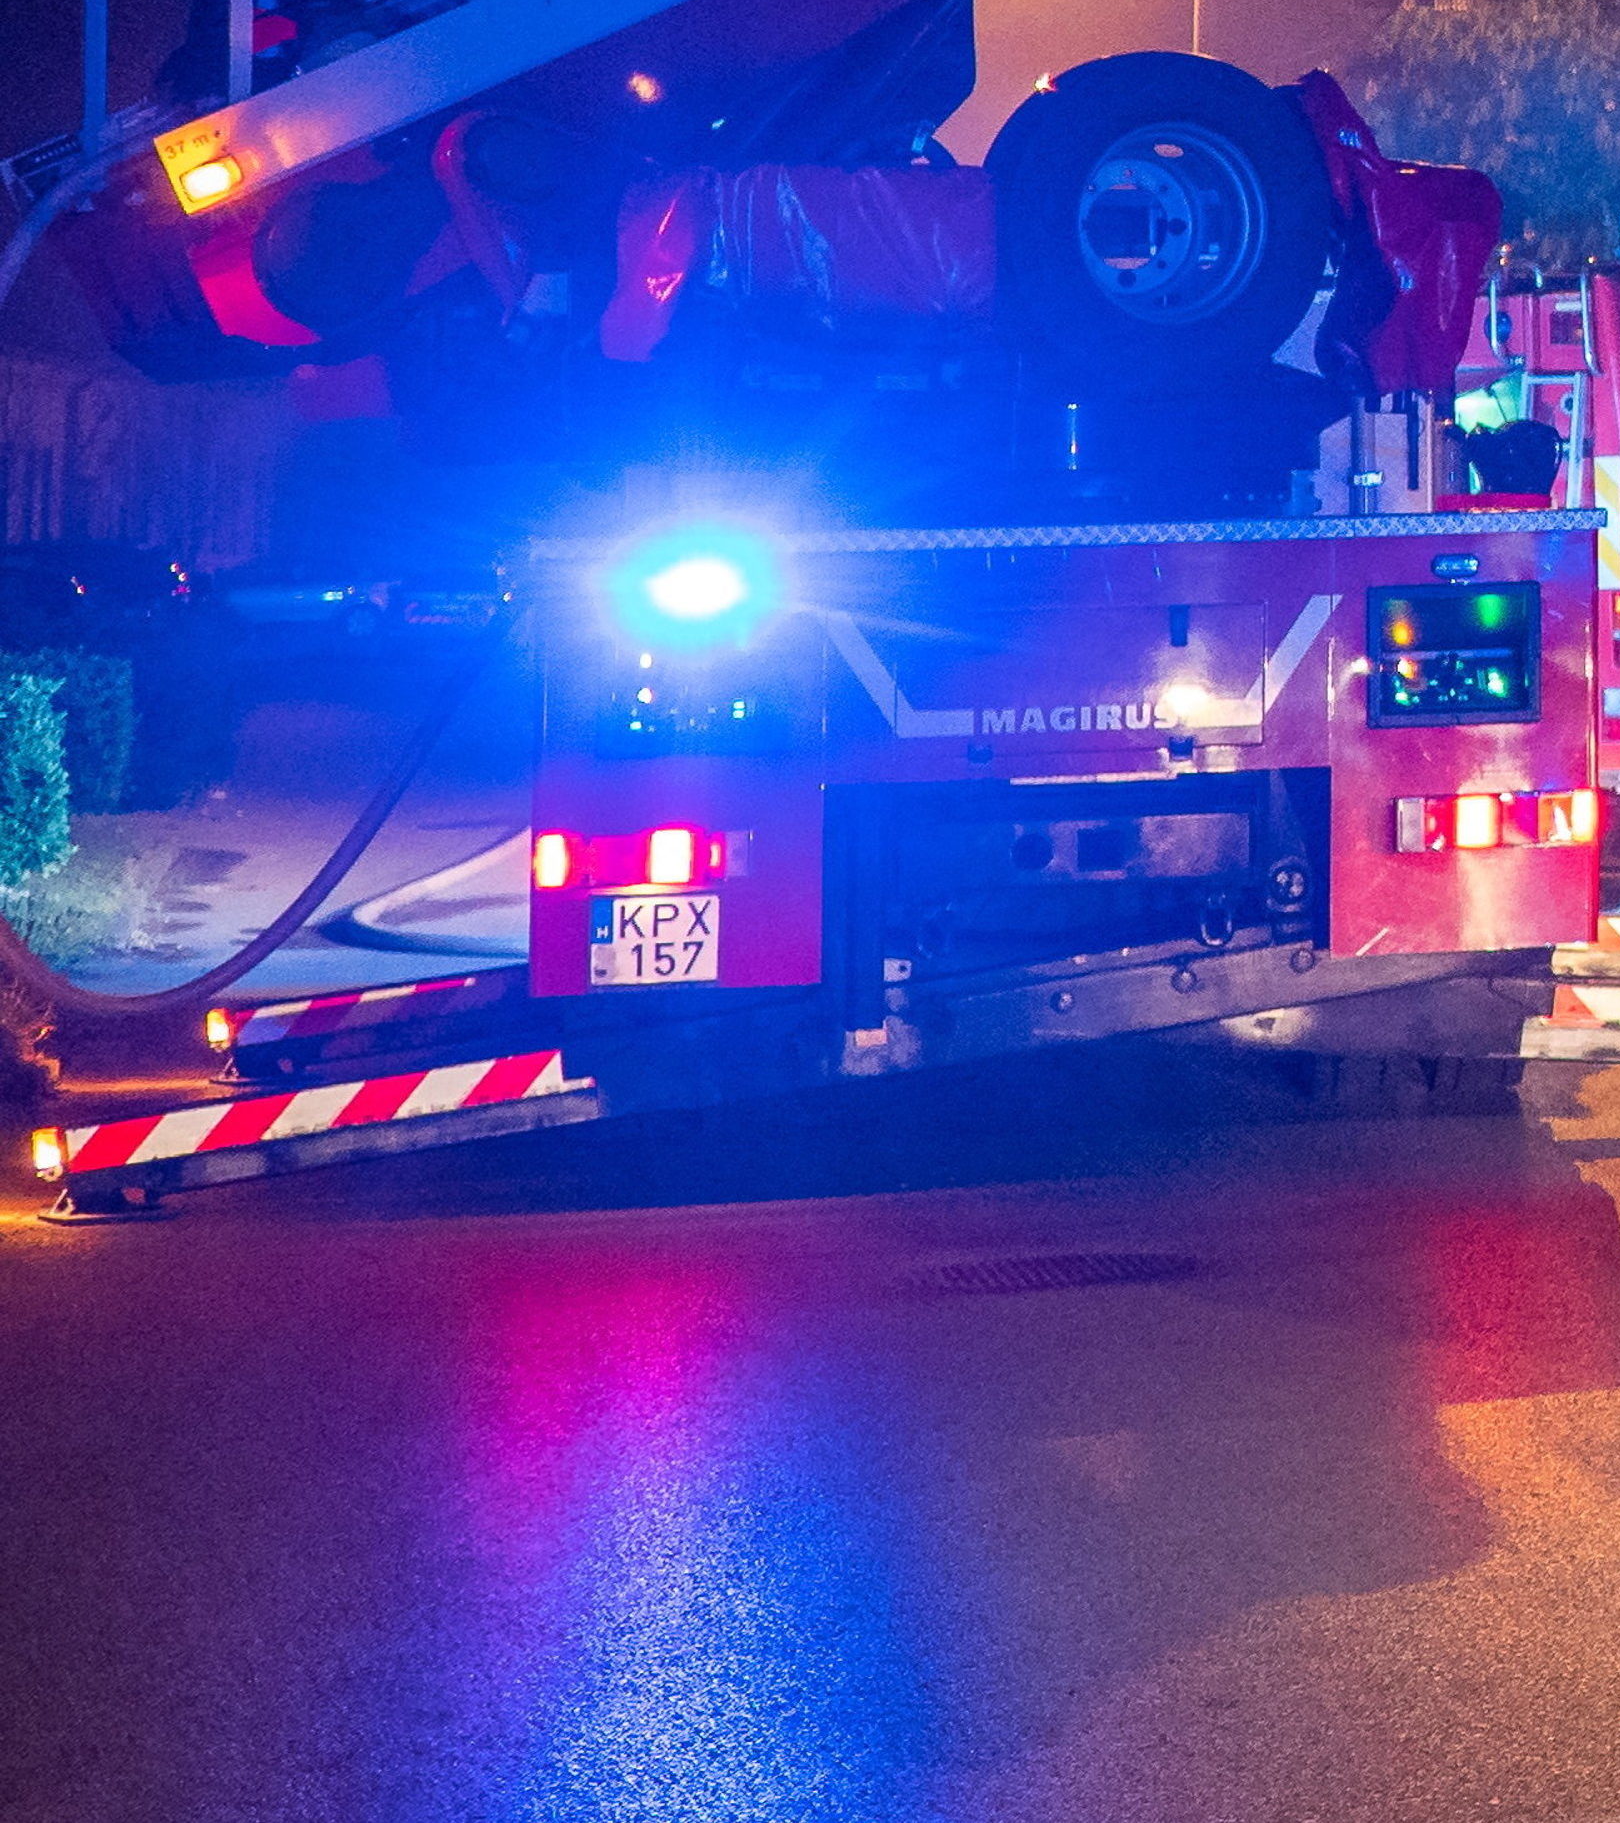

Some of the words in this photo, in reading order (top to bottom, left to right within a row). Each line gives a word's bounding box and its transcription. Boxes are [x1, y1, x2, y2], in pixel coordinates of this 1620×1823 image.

[981, 703, 1180, 735] MAGIRUS
[619, 899, 711, 939] KPX
[631, 940, 704, 977] 157
